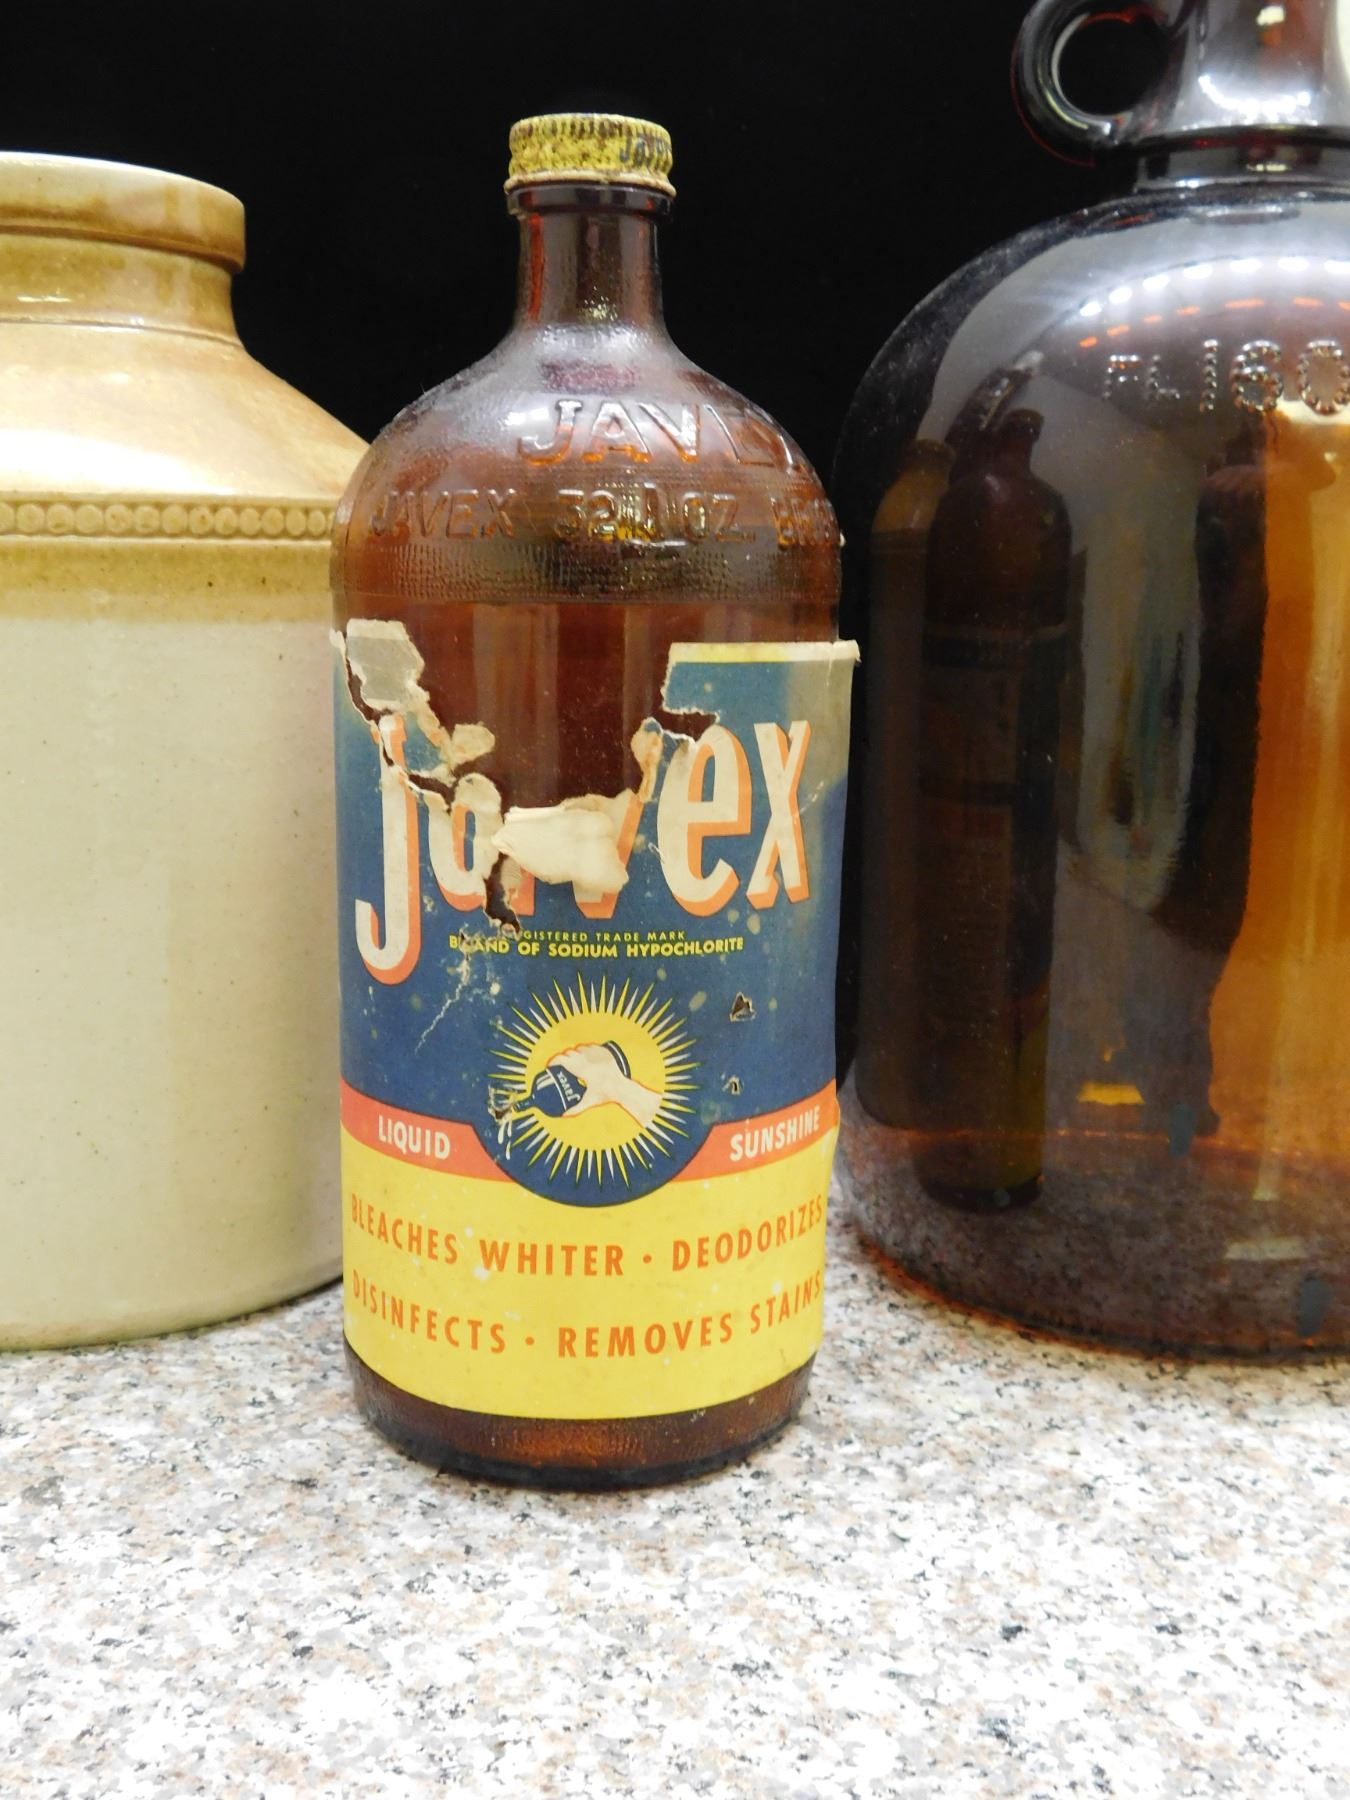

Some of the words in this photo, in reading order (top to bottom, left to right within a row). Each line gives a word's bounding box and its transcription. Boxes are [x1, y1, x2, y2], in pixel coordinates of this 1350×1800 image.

[449, 934, 510, 954] BAND
[517, 940, 541, 956] OF
[548, 942, 618, 958] SODIUM
[626, 935, 745, 958] HYPOCHLORITE
[523, 930, 588, 942] GISTERED
[595, 931, 640, 942] TRADE
[647, 930, 686, 941] MARK
[378, 1114, 451, 1160] LIQUID
[729, 1104, 821, 1162] SUNSHINE
[351, 1192, 459, 1265] BLEACHES
[479, 1239, 624, 1277] WHITER
[671, 1194, 823, 1273] DEODORIZES
[353, 1268, 506, 1355] DISINFECTS
[558, 1312, 733, 1358] REMOVES
[749, 1269, 821, 1335] STAINS
